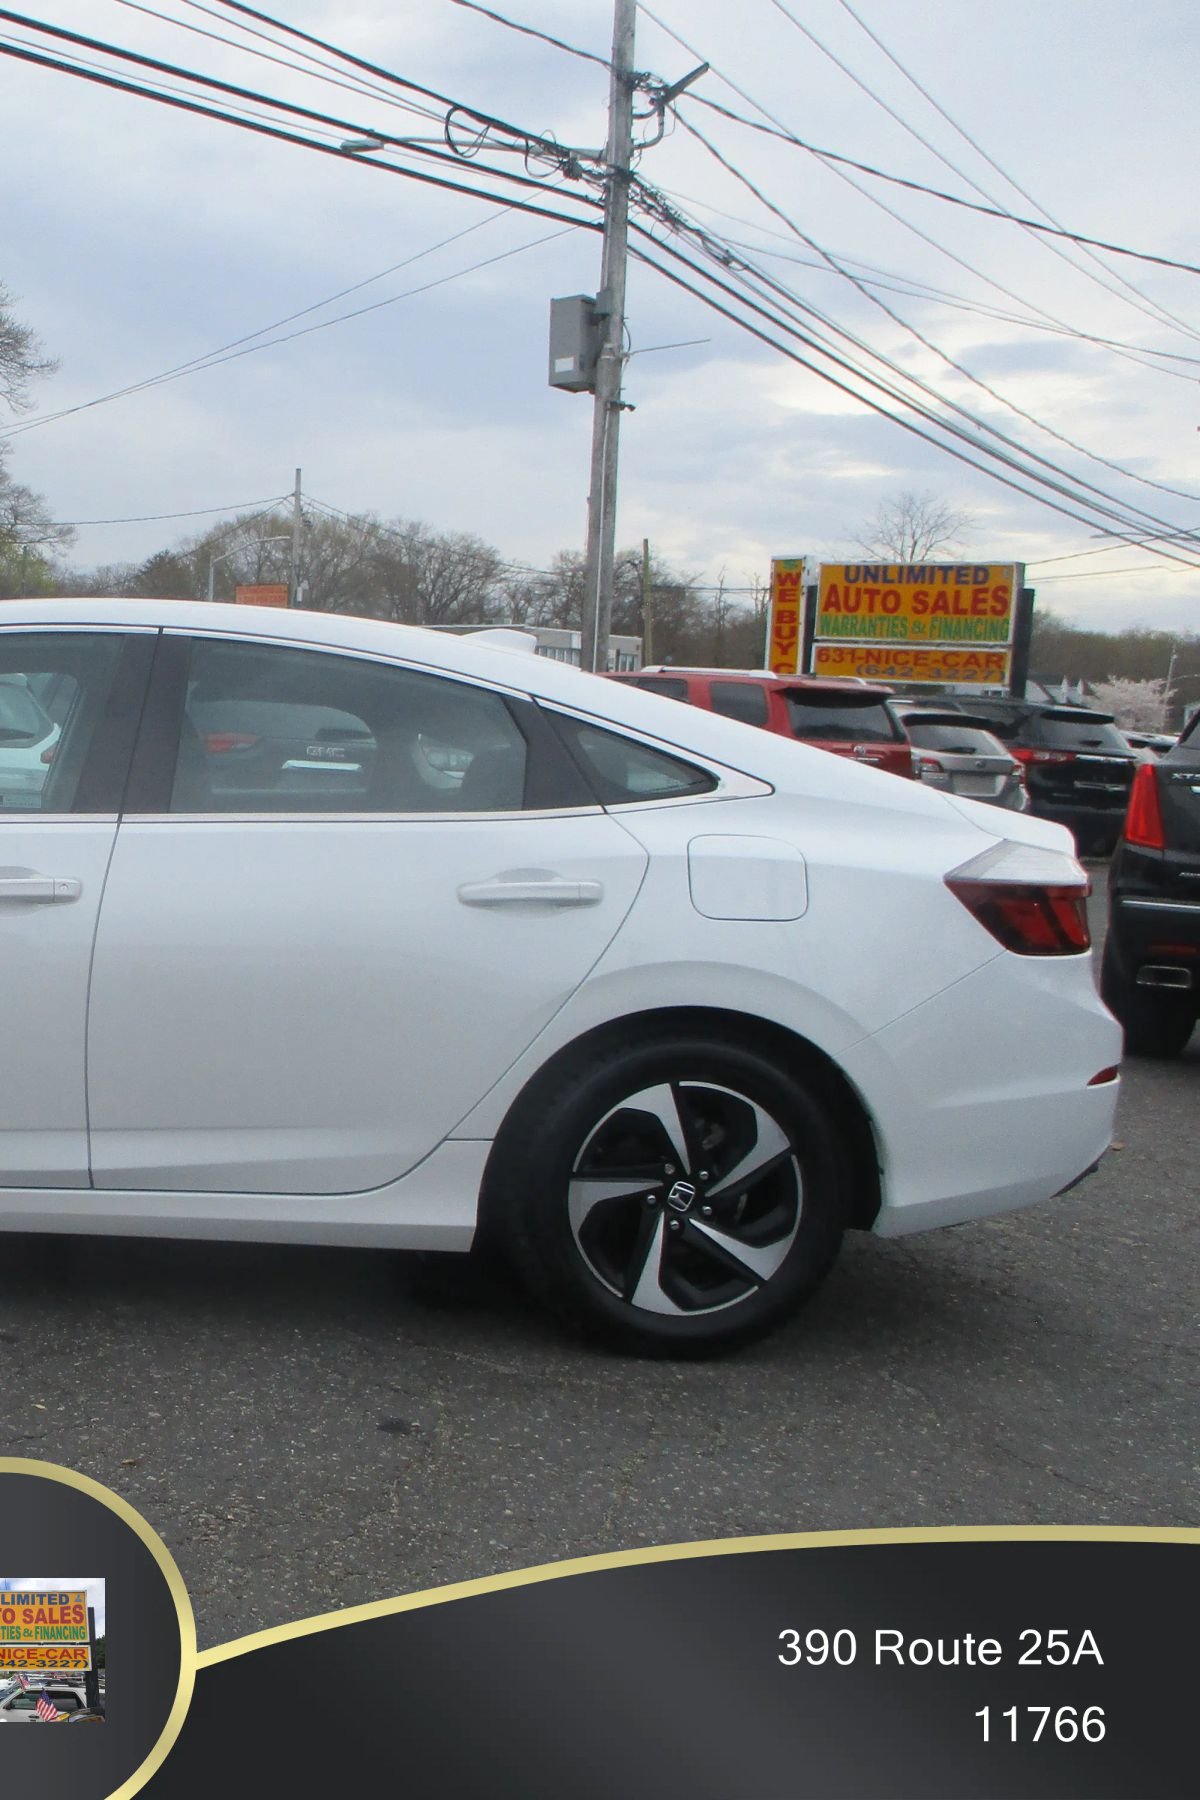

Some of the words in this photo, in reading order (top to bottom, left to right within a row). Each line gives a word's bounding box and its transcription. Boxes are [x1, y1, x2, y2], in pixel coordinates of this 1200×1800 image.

[777, 572, 801, 602] WE
[844, 565, 990, 585] UNLIMITED
[822, 583, 902, 614] AUTO
[911, 585, 1009, 616] SALES
[774, 609, 797, 656] BUY
[820, 614, 908, 639] WARRANTIES
[911, 619, 926, 635] &
[929, 616, 1010, 641] FINANCING
[816, 648, 1004, 670] 631-NICE-CAR
